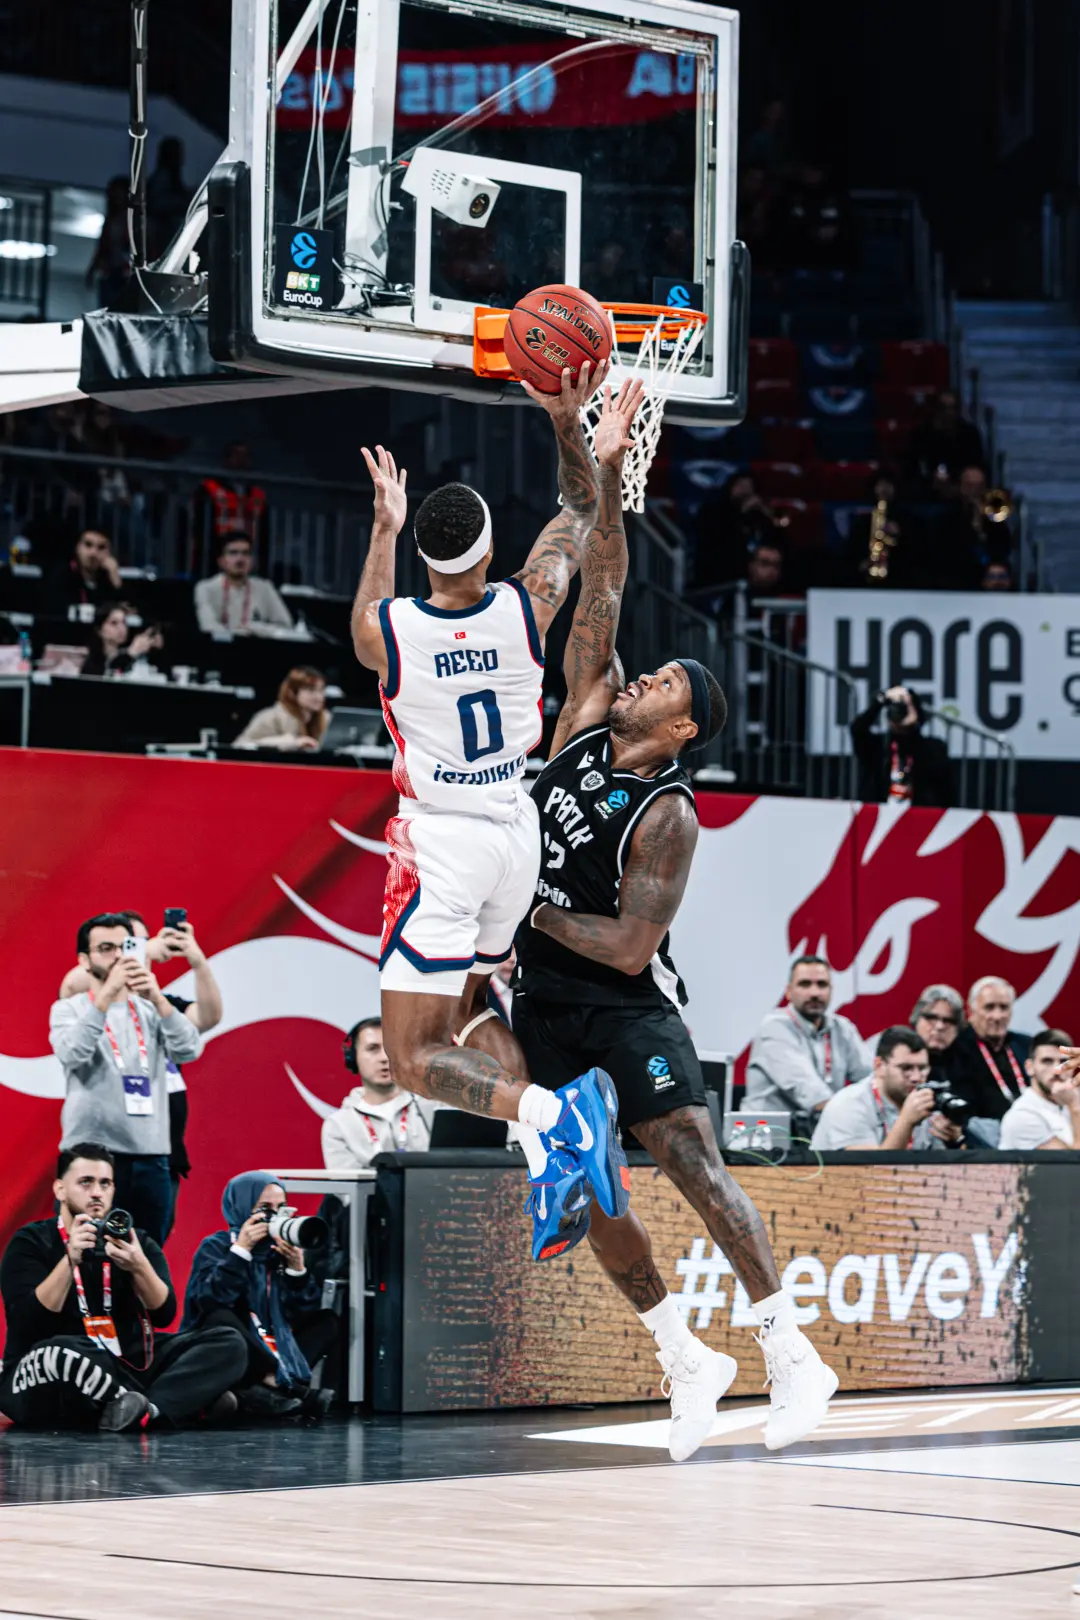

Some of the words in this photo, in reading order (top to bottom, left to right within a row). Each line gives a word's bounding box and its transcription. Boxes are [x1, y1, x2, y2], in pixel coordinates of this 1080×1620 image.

[283, 290, 323, 308] EuroCup
[287, 273, 320, 290] BKT
[538, 299, 603, 351] SPALDING
[434, 649, 498, 678] REED
[456, 688, 504, 763] 0
[668, 1233, 1029, 1328] #LeaveY
